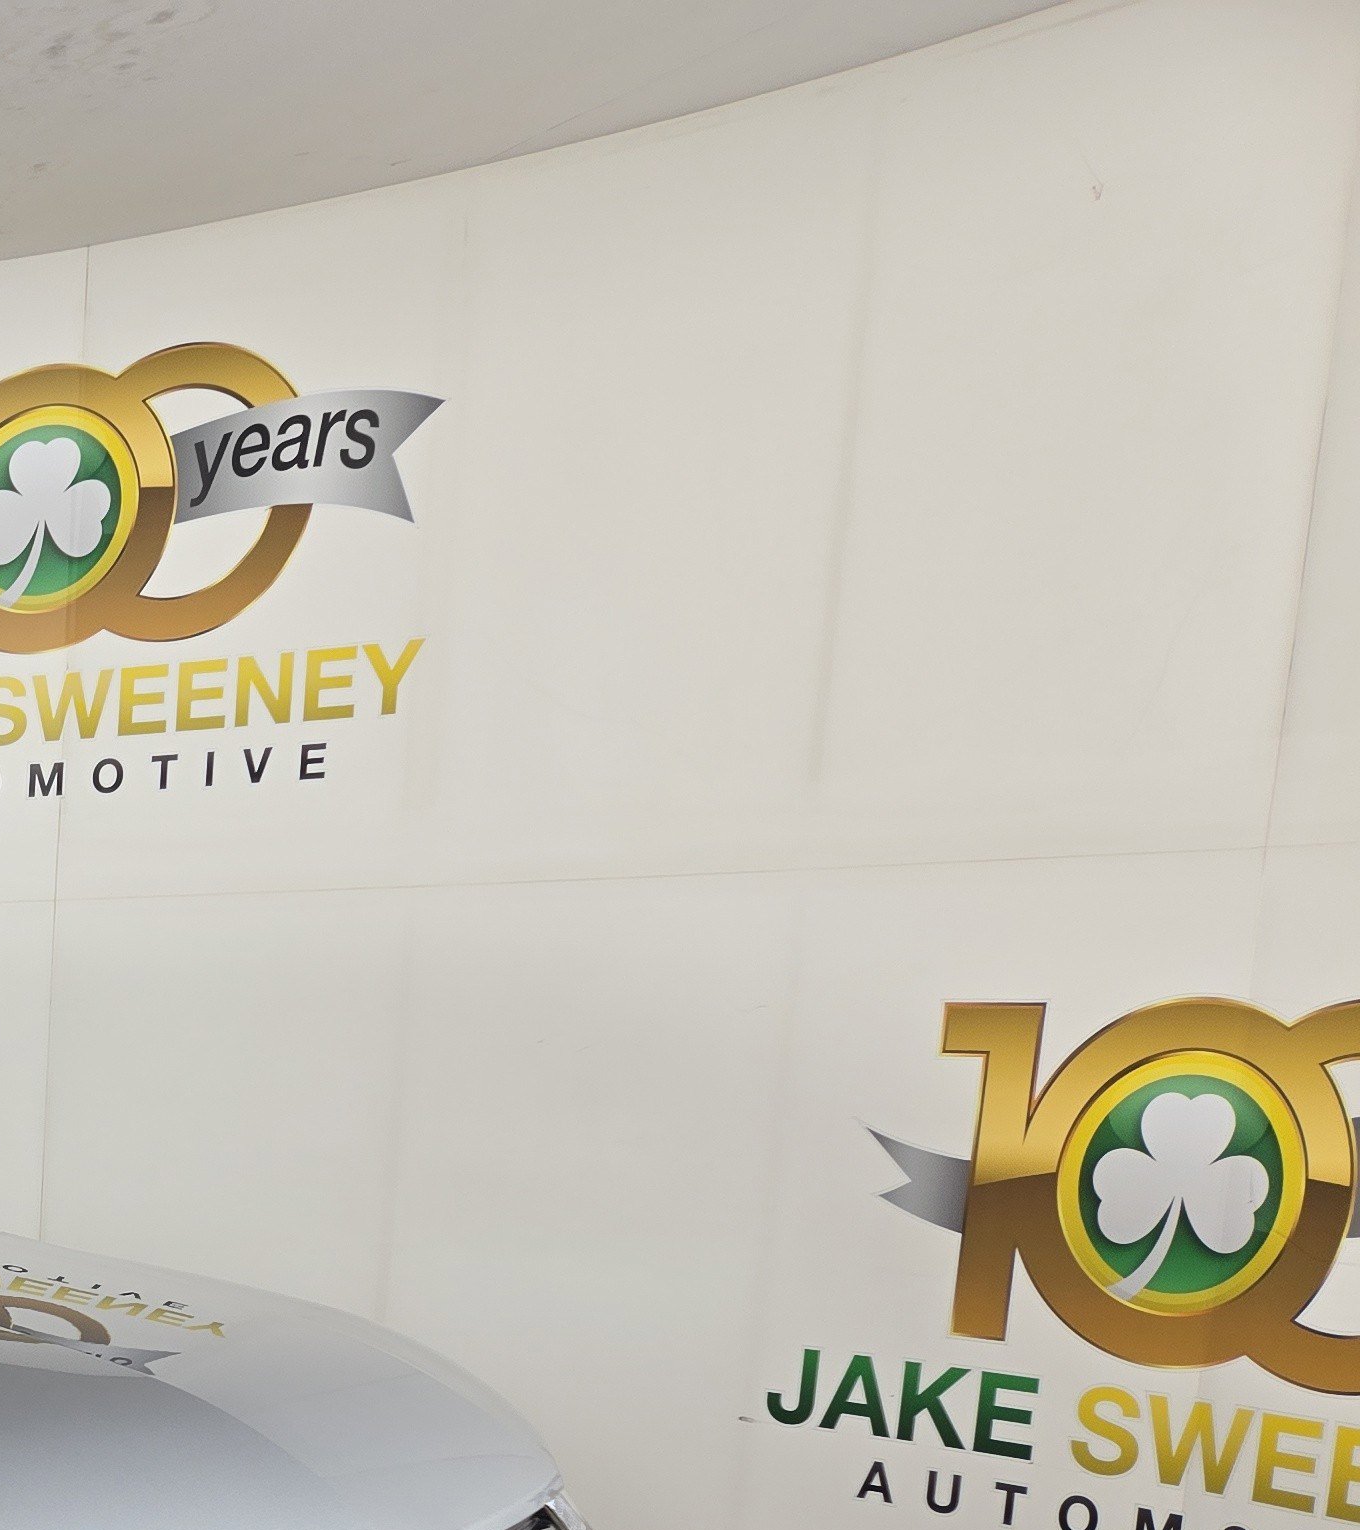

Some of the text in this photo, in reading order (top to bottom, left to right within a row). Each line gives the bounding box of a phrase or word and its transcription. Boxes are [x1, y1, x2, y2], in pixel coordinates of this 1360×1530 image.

[189, 408, 380, 507] years
[941, 997, 1360, 1395] 10
[766, 1348, 1040, 1462] JAKE
